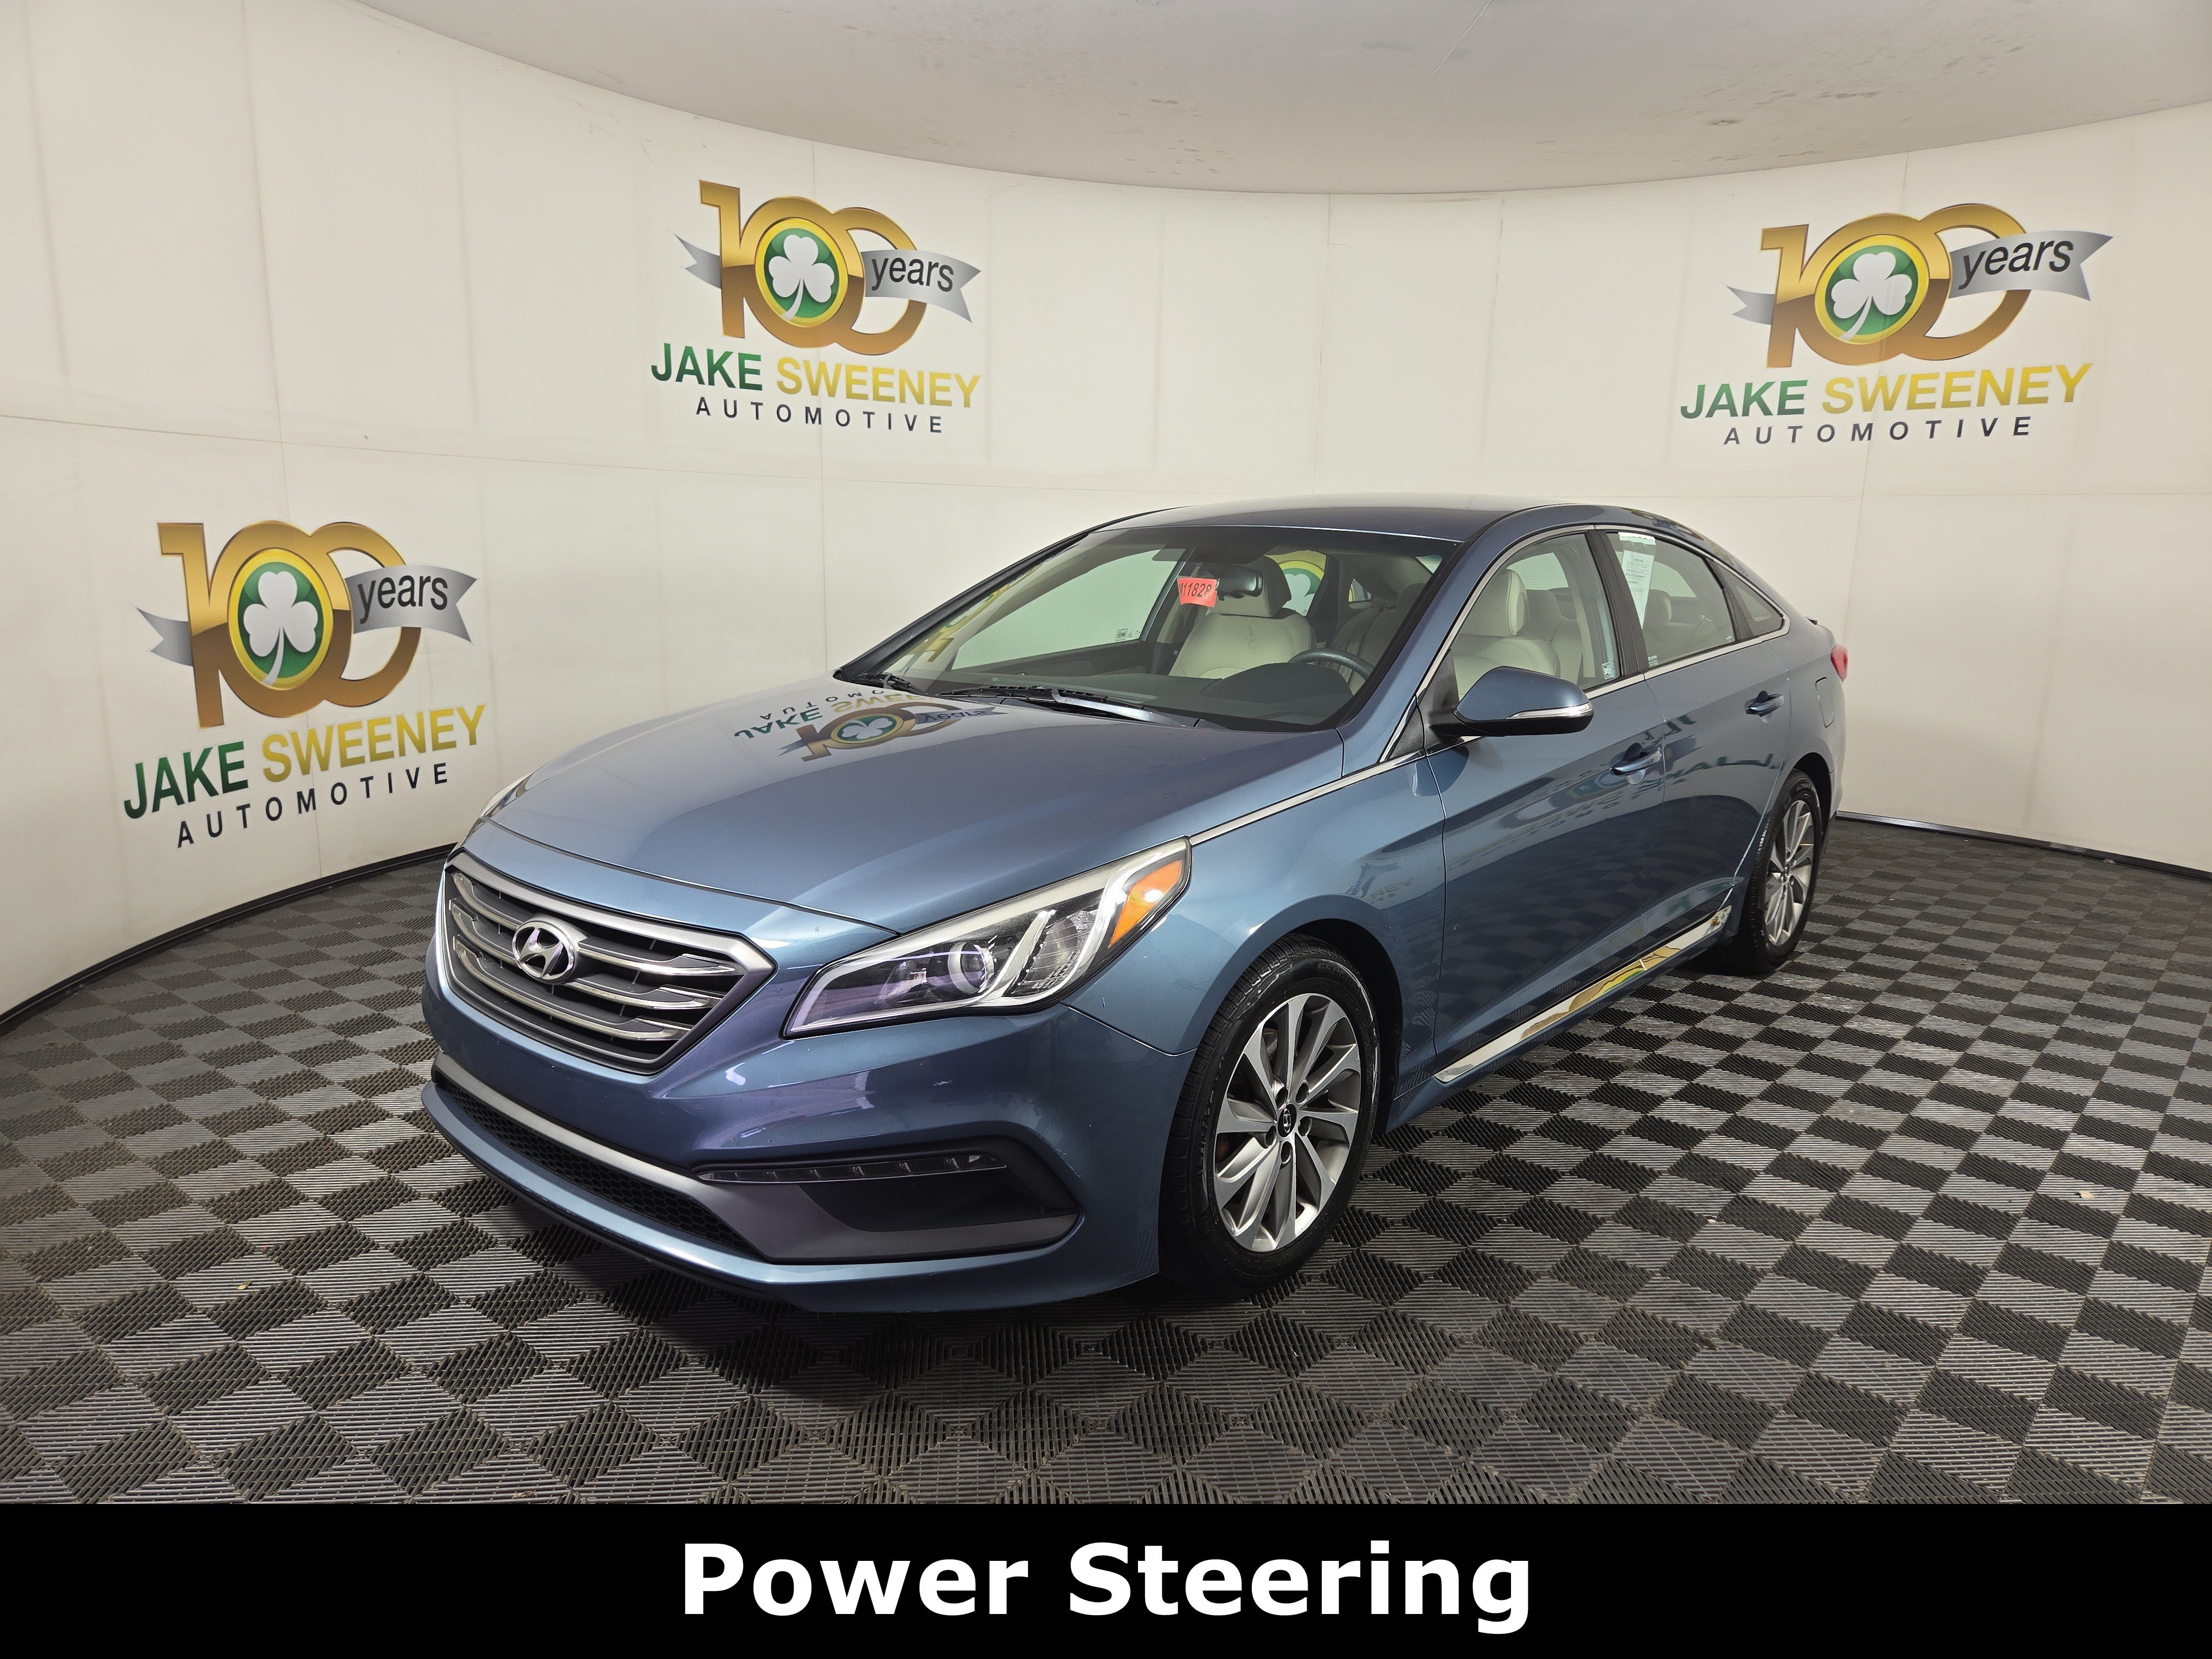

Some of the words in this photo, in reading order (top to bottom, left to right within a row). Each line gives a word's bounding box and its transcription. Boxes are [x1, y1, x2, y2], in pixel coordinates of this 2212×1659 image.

[699, 179, 928, 356] 100
[871, 257, 954, 292] years
[1759, 203, 2032, 368] 100
[1958, 239, 2074, 290] years
[651, 343, 763, 391] JAKE
[776, 357, 981, 408] SWEENEY
[1681, 380, 1808, 419] JAKE
[1822, 363, 2093, 414] SWEENEY
[696, 397, 941, 433] AUTOMOTIVE
[1724, 416, 2031, 446] AUTOMOTIVE
[157, 520, 421, 729] 100
[357, 575, 448, 624] years
[124, 741, 248, 819] JAKE
[261, 705, 485, 782] SWEENEY
[178, 763, 448, 847] AUTOMOTIVE
